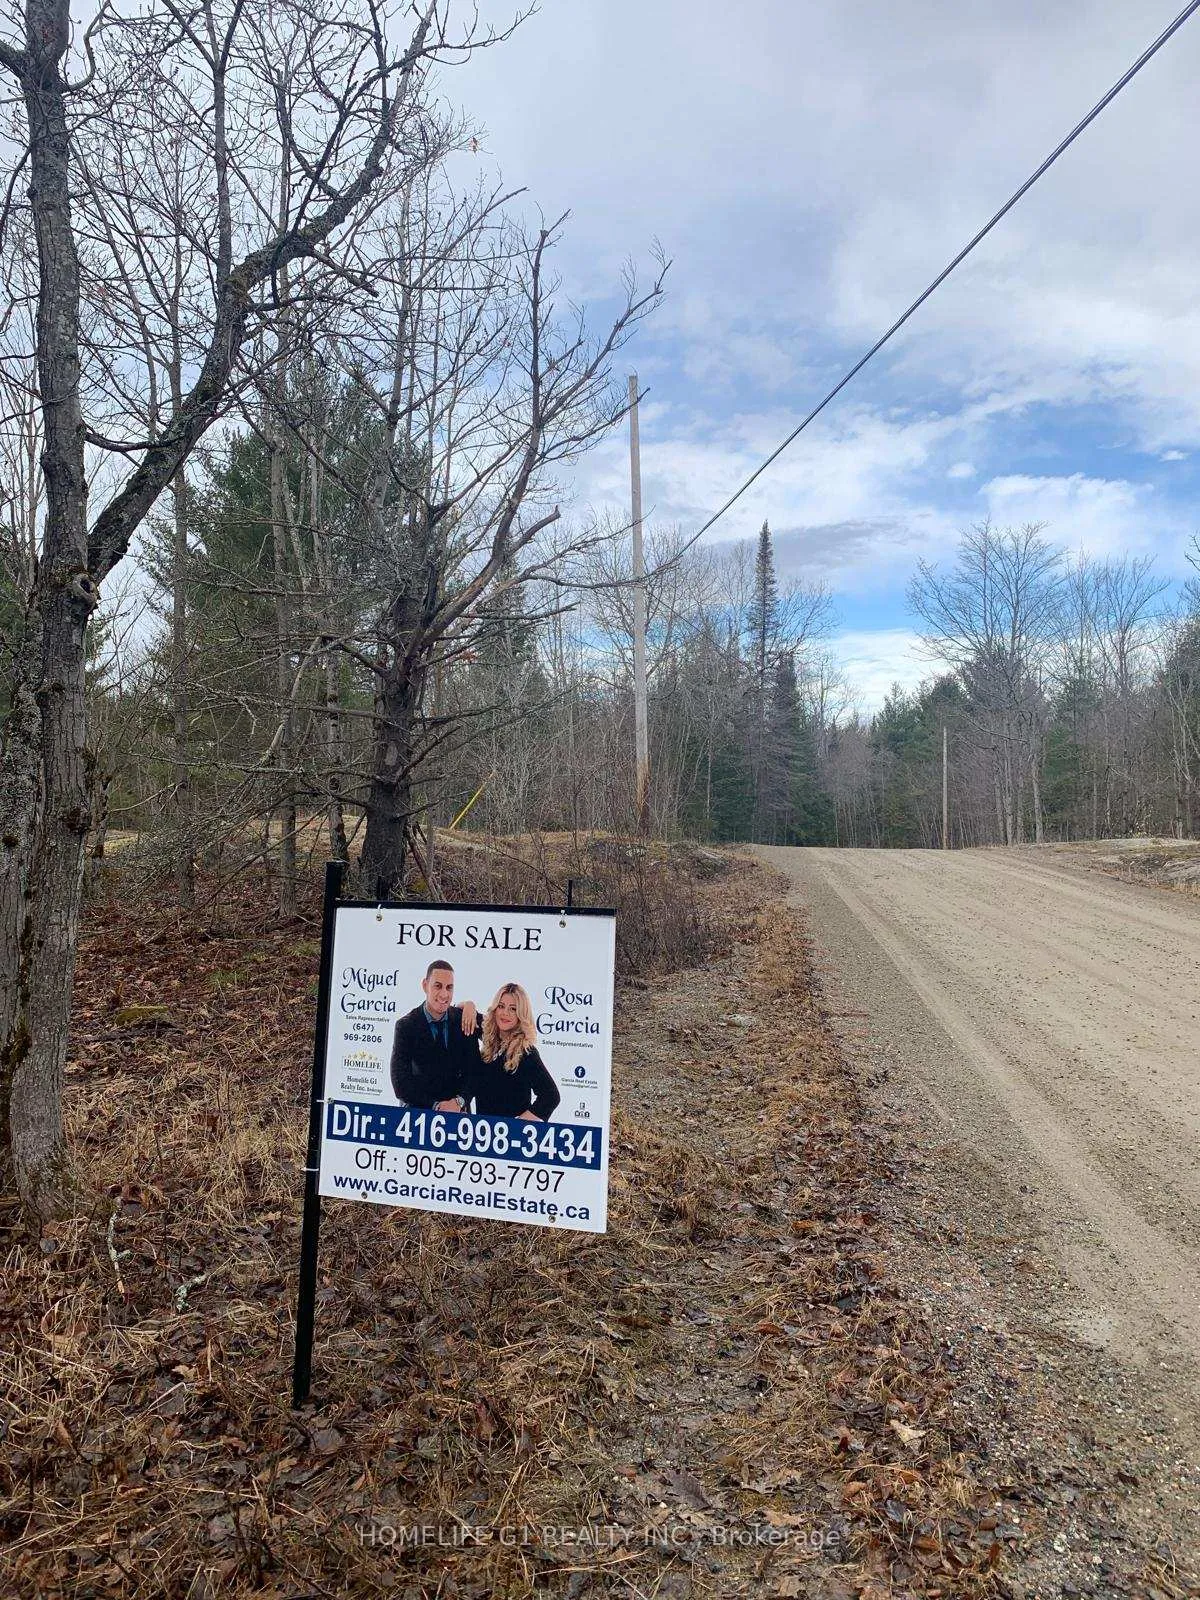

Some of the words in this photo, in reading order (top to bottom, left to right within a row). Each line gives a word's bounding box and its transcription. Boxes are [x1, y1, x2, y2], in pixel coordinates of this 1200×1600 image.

[397, 923, 456, 947] FOR
[464, 925, 542, 951] SALE
[342, 967, 400, 992] Miguel
[340, 993, 397, 1014] Garcia
[544, 986, 593, 1012] Rosa
[353, 1023, 374, 1031] (647)
[536, 1013, 600, 1034] Garcia
[344, 1033, 382, 1043] 969-2806
[556, 1041, 594, 1049] Representative
[332, 1103, 386, 1141] Dir.:
[395, 1111, 595, 1164] 416-998-3434
[355, 1147, 398, 1174] Off.:
[406, 1153, 565, 1193] 905-793-7797
[333, 1175, 590, 1220] www.GarciaRealEstate.ca
